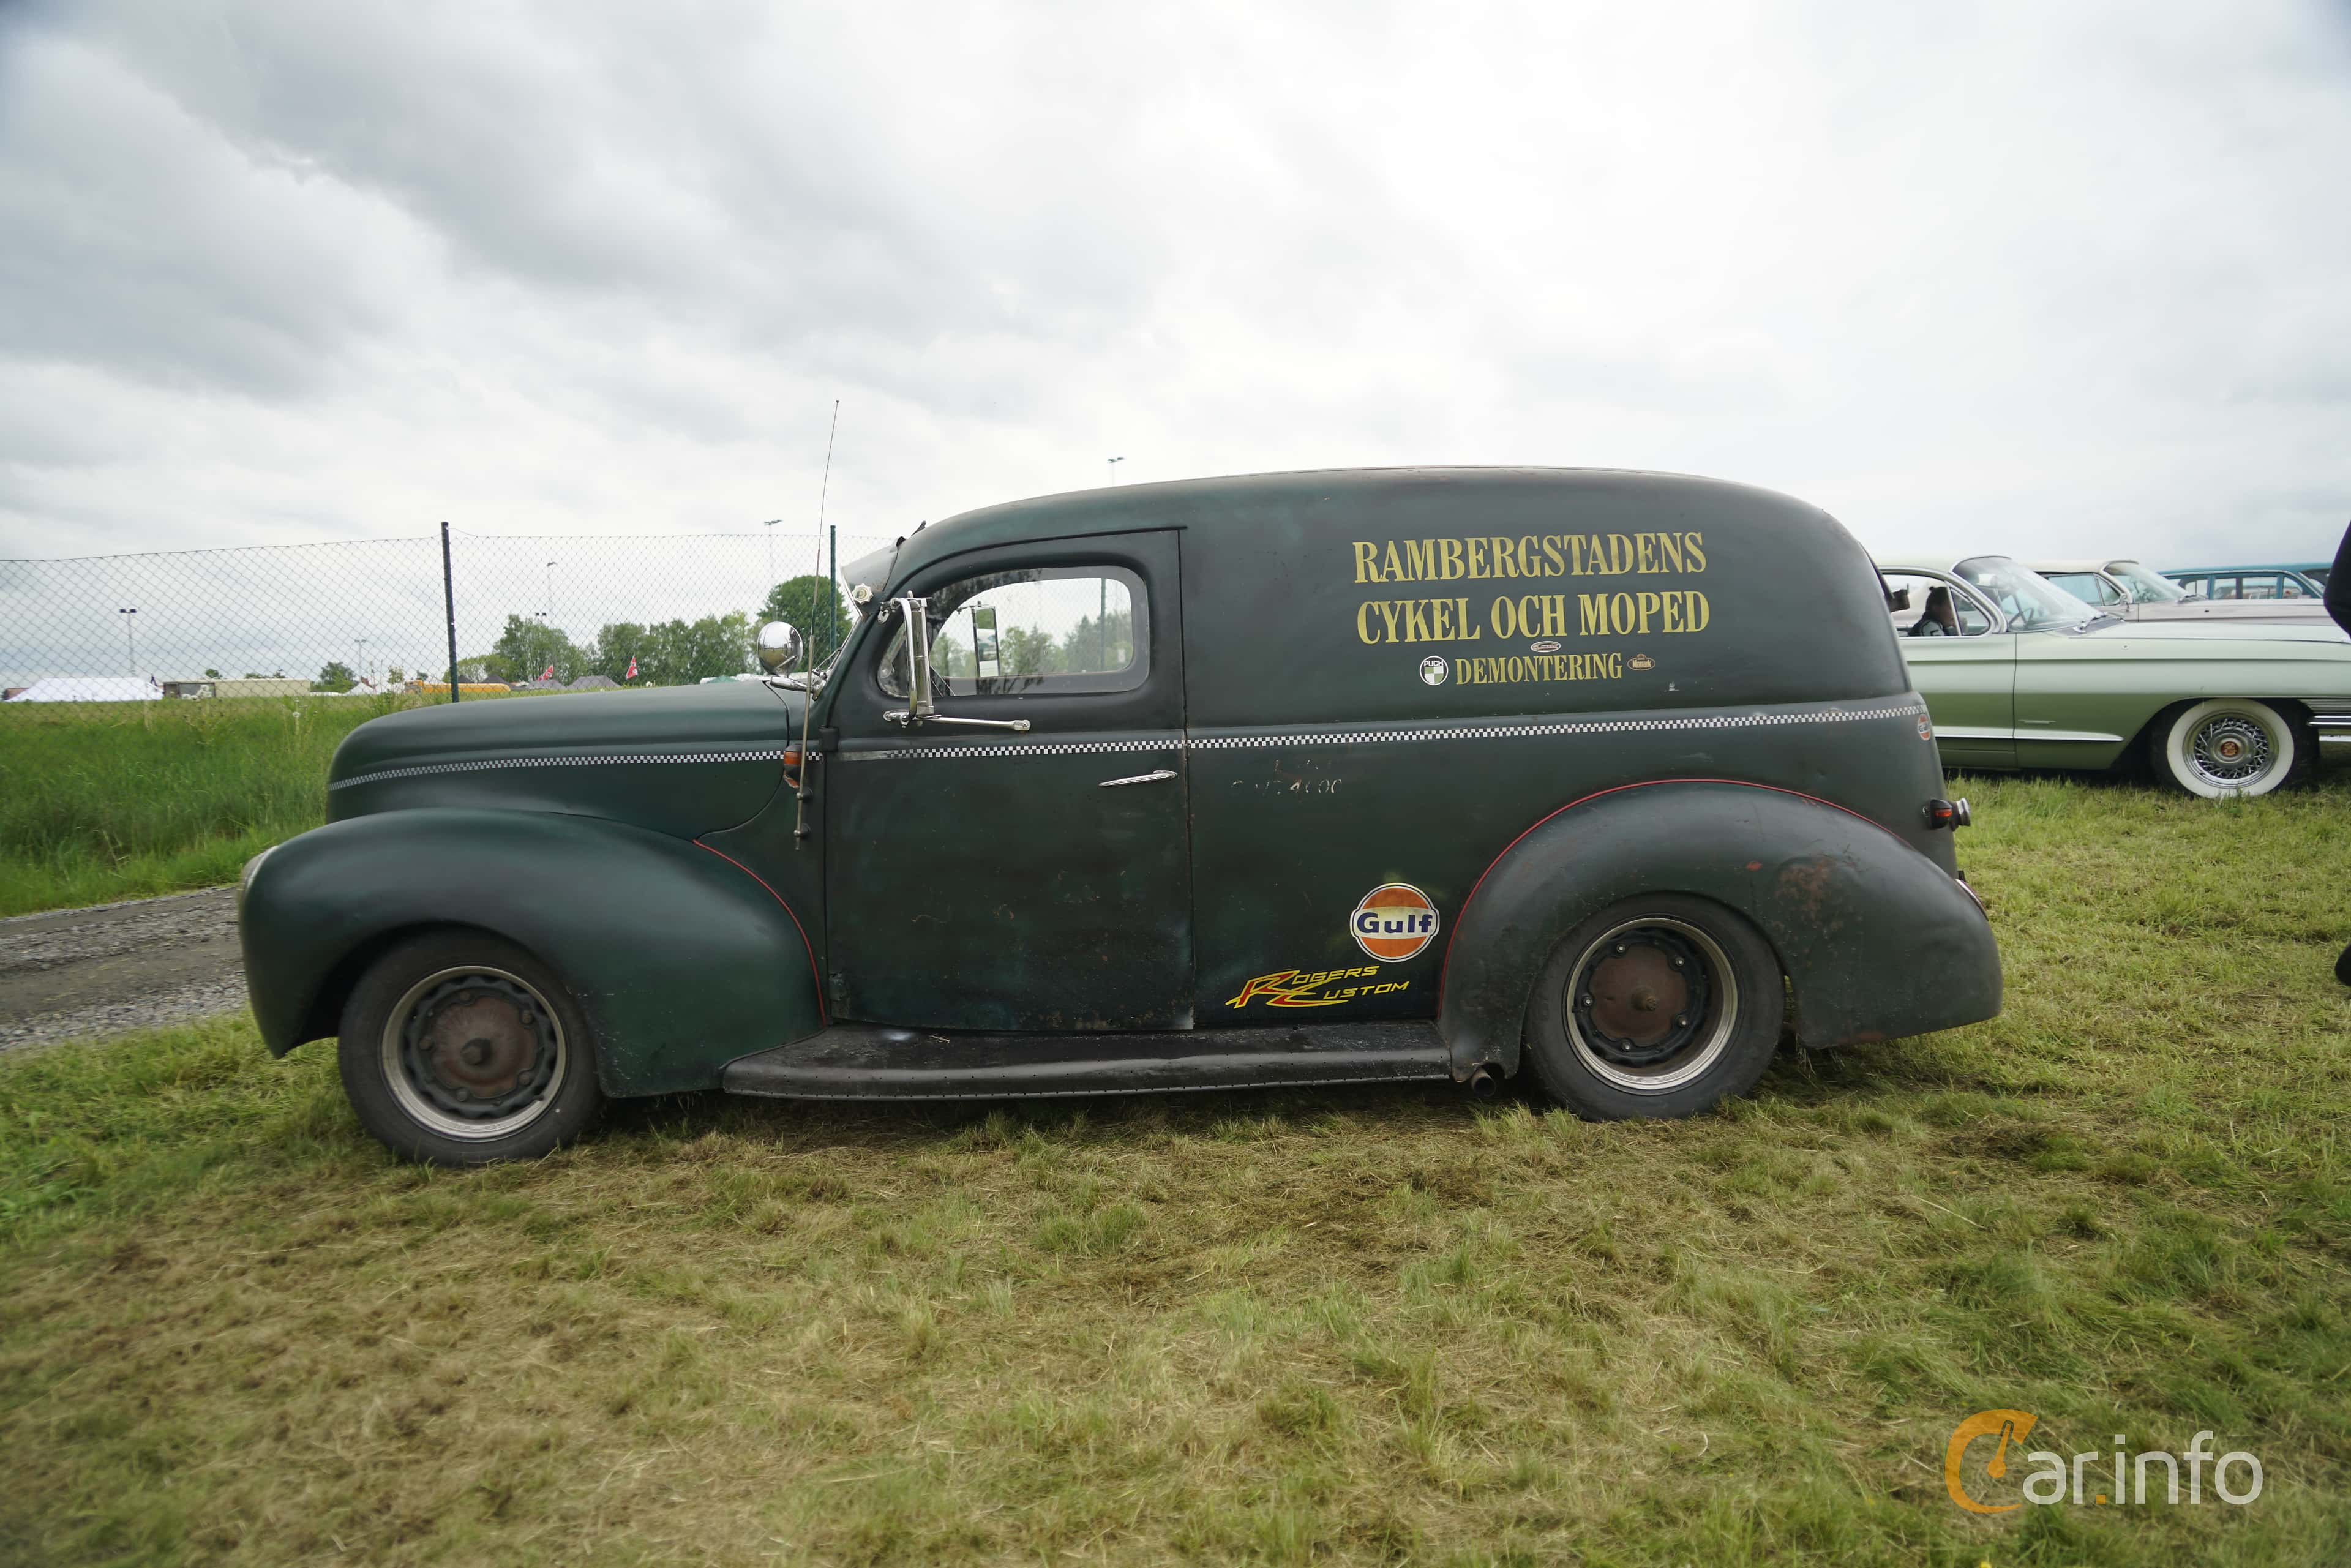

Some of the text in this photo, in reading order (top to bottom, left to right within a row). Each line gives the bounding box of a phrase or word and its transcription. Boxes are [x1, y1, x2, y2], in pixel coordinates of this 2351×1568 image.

[1352, 532, 1707, 583] RAMBERGSTADENS
[1357, 591, 1709, 645] CYKEL OCH MOPED
[1455, 653, 1622, 685] DEMONTERING
[1356, 912, 1433, 934] Gulf
